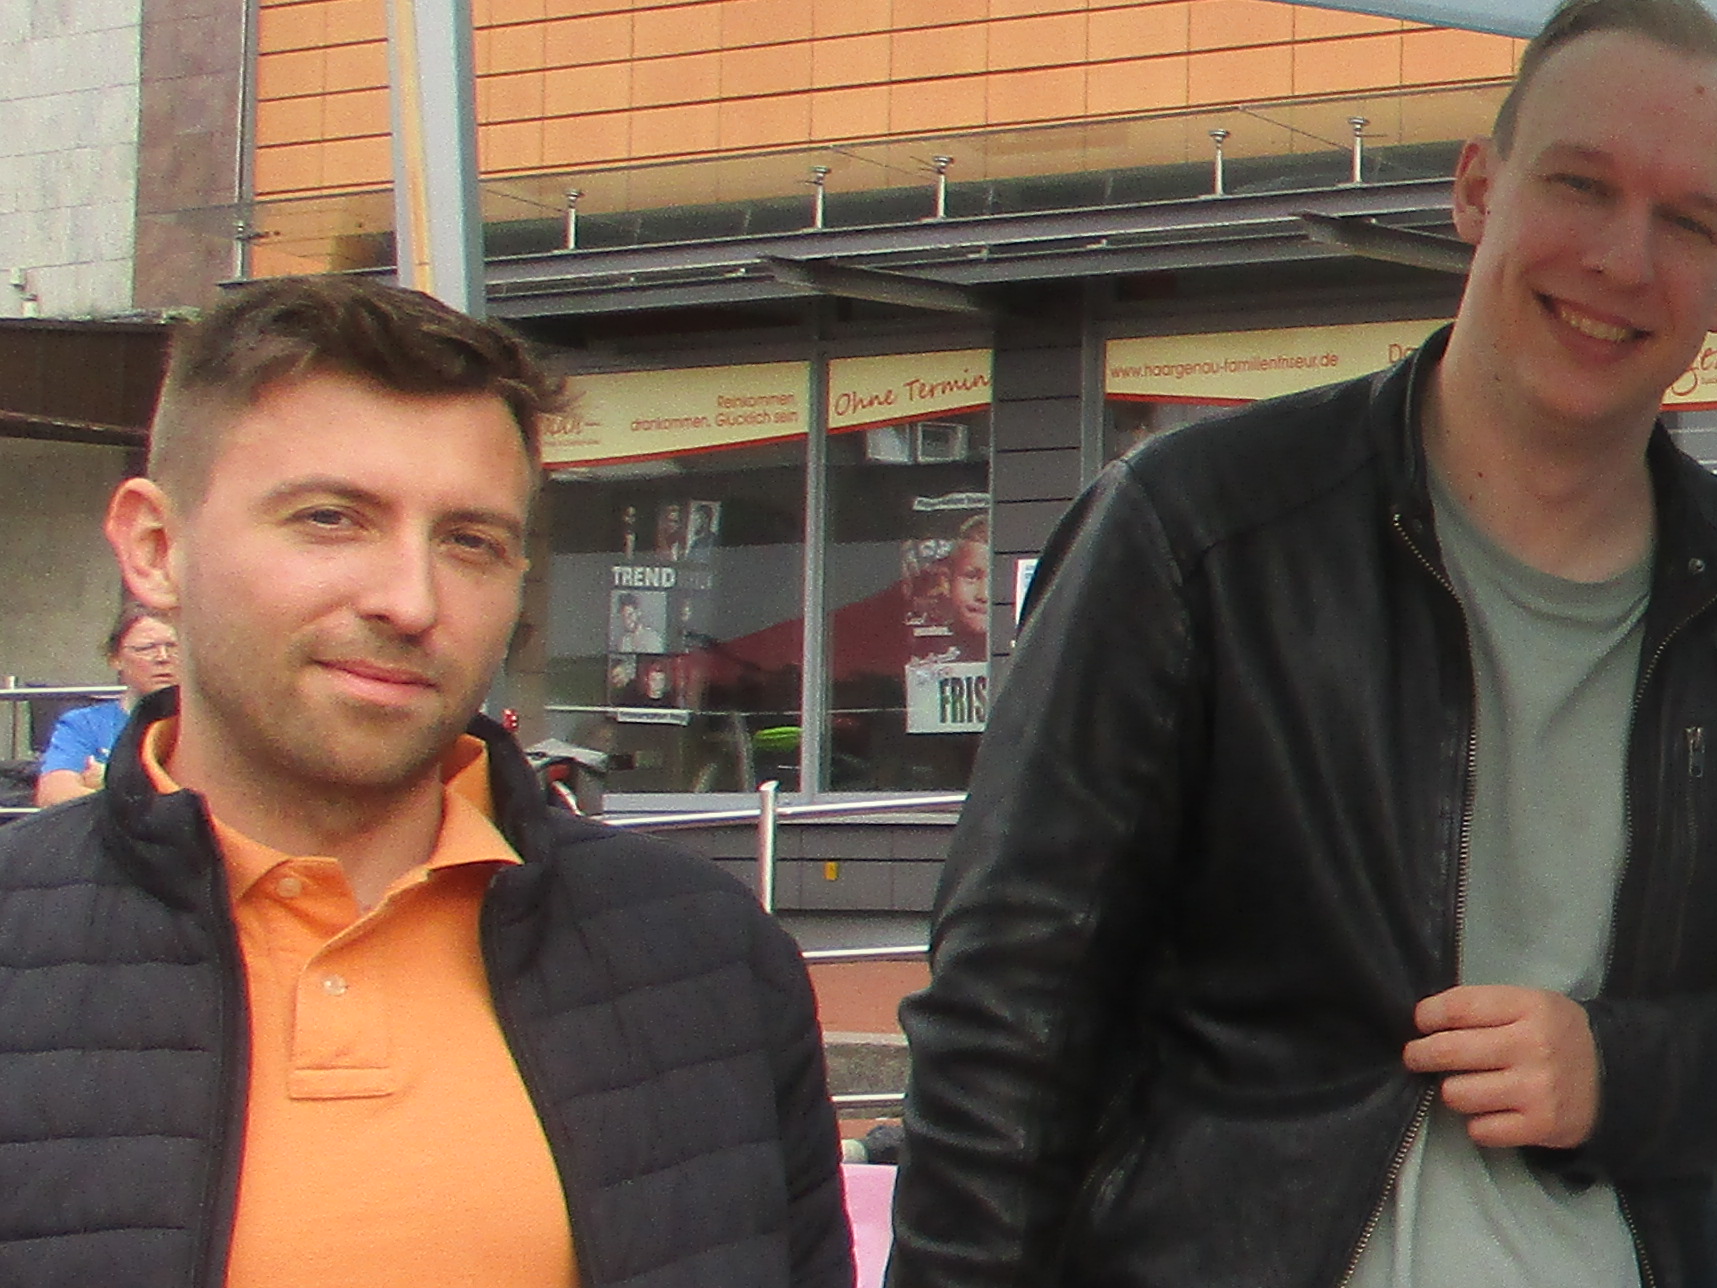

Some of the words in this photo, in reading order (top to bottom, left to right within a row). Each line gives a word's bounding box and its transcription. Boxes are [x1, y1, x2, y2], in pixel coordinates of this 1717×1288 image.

[834, 389, 896, 416] Ohne
[903, 369, 991, 401] Termin
[612, 567, 676, 587] TREND
